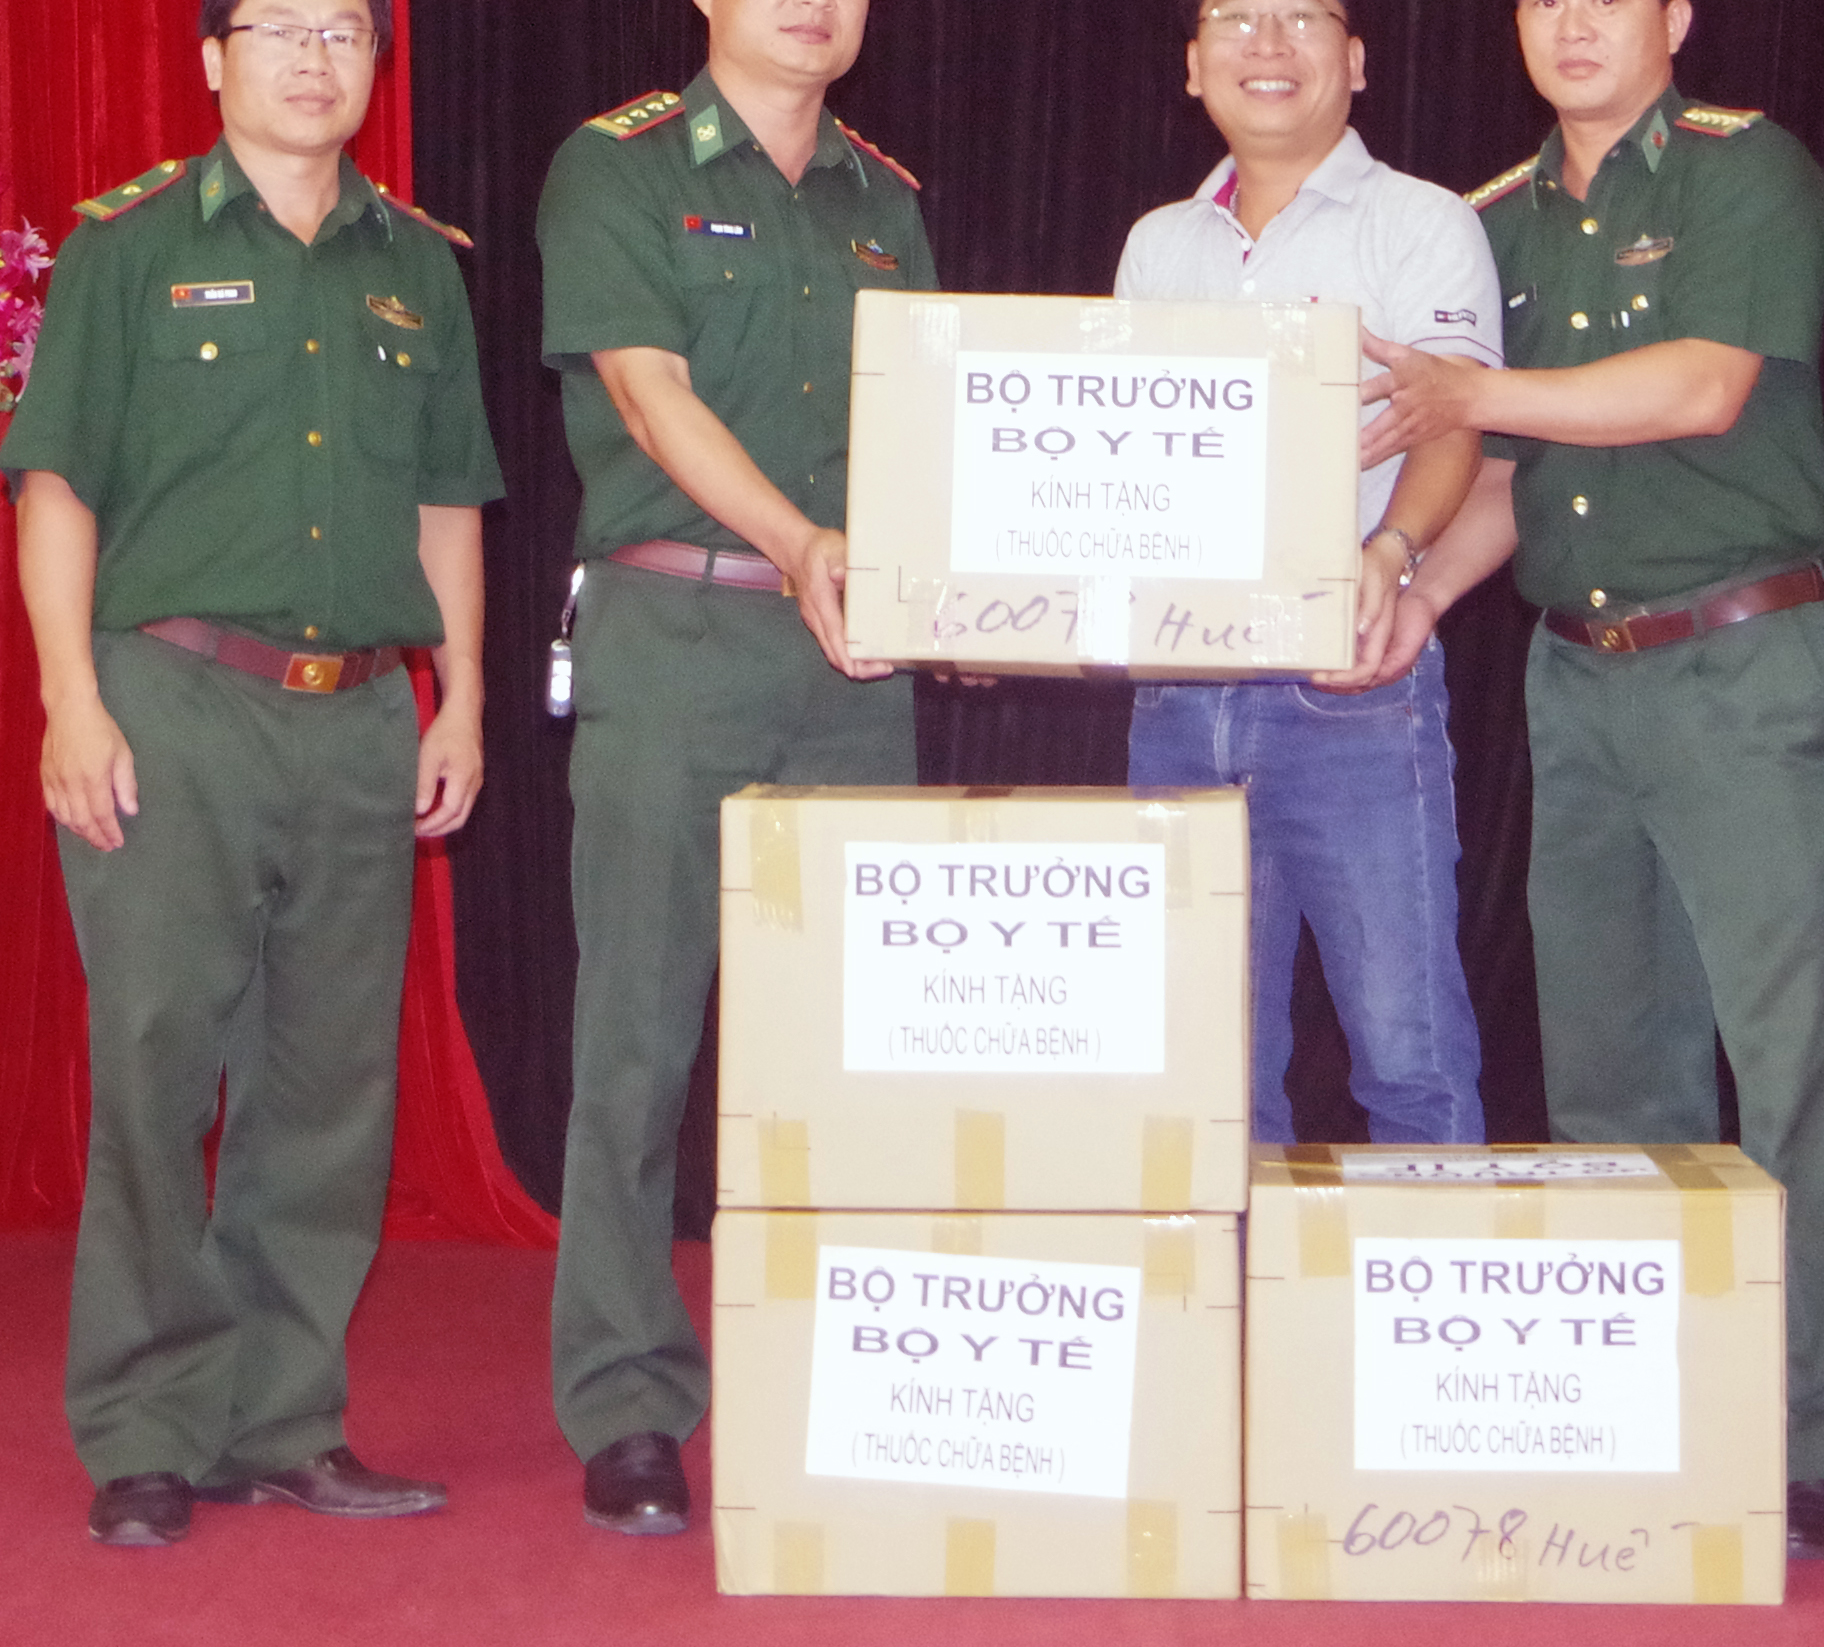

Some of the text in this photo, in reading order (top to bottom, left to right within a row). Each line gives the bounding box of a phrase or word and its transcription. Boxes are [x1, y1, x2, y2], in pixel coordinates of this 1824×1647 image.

[966, 368, 1254, 414] BỘ TRƯỞNG
[990, 425, 1226, 461] BỘ Y TẾ
[1031, 474, 1172, 517] KÍNH TẶNG
[1078, 527, 1134, 560] CHỮA
[1137, 530, 1191, 566] BỆNH
[933, 590, 1138, 647] 6007
[855, 857, 1151, 904] BỘ TRƯỞNG
[882, 915, 1122, 954] BỘ Y TẾ
[924, 969, 1067, 1010] KÍNH TẶNG
[975, 1022, 1030, 1055] CHỮA
[1036, 1024, 1088, 1060] BỆNH
[828, 1265, 1125, 1322] BỘ TRƯỞNG
[1365, 1254, 1665, 1302] BỘ TRƯỞNG
[852, 1325, 1093, 1370] BỘ Y TẾ
[1393, 1312, 1637, 1352] BỘ Y TẾ
[890, 1377, 1035, 1426] KÍNH TẶNG
[1436, 1366, 1582, 1409] KÍNH TẶNG
[938, 1436, 994, 1471] CHỮA
[999, 1441, 1053, 1479] BỆNH
[1487, 1420, 1545, 1455] CHỮA
[1551, 1422, 1605, 1461] BỆNH
[1342, 1503, 1528, 1563] 60078
